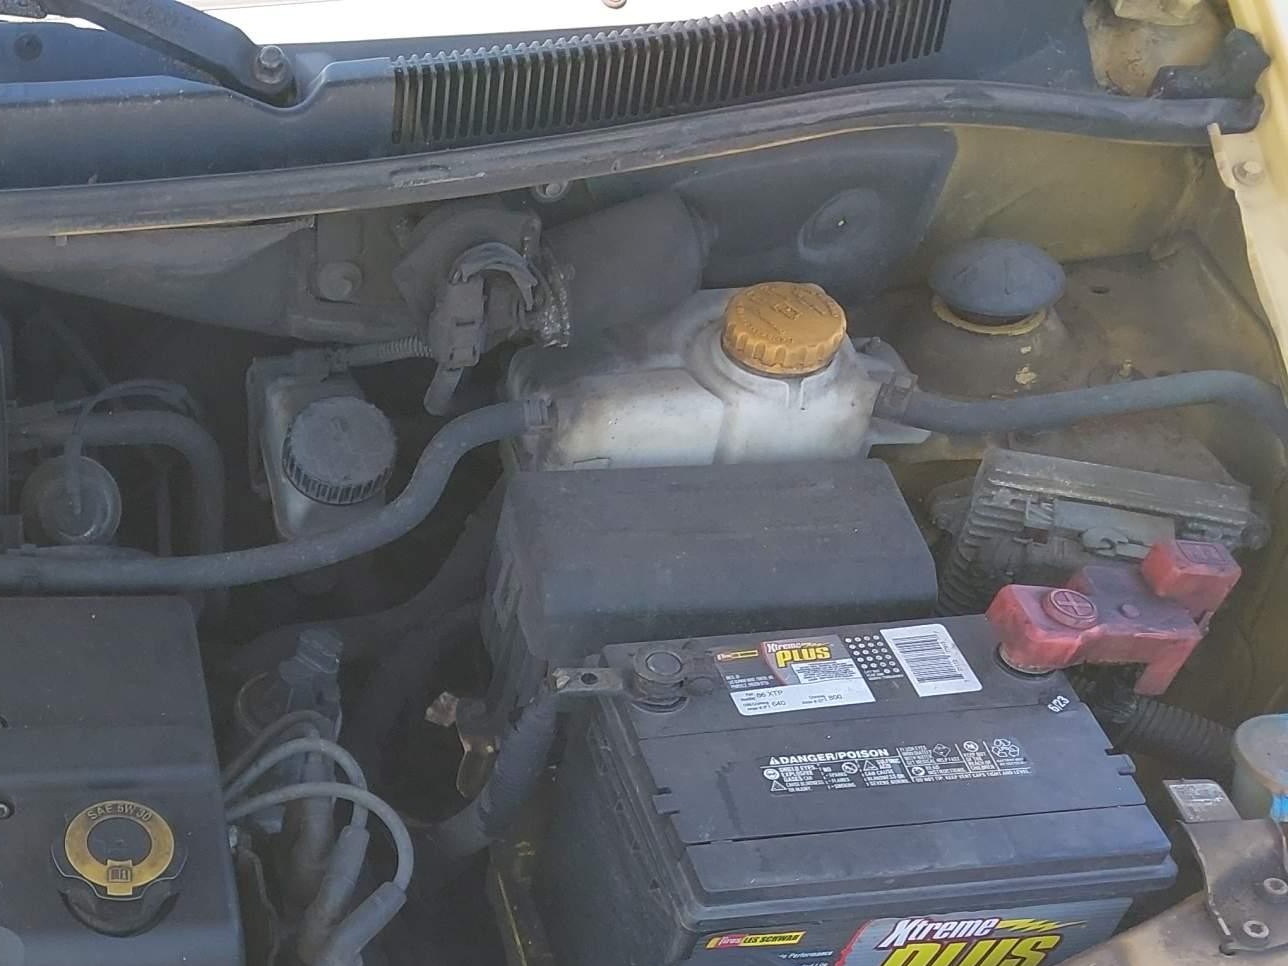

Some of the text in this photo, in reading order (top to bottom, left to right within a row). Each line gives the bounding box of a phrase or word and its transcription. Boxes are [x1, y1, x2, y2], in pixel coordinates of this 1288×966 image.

[767, 642, 801, 653] Xtreme
[775, 646, 831, 668] PLUS
[1047, 696, 1070, 712] 6/23
[779, 748, 889, 764] DANGER/POISON
[87, 804, 113, 821] SAE
[878, 917, 1001, 948] Xtreme
